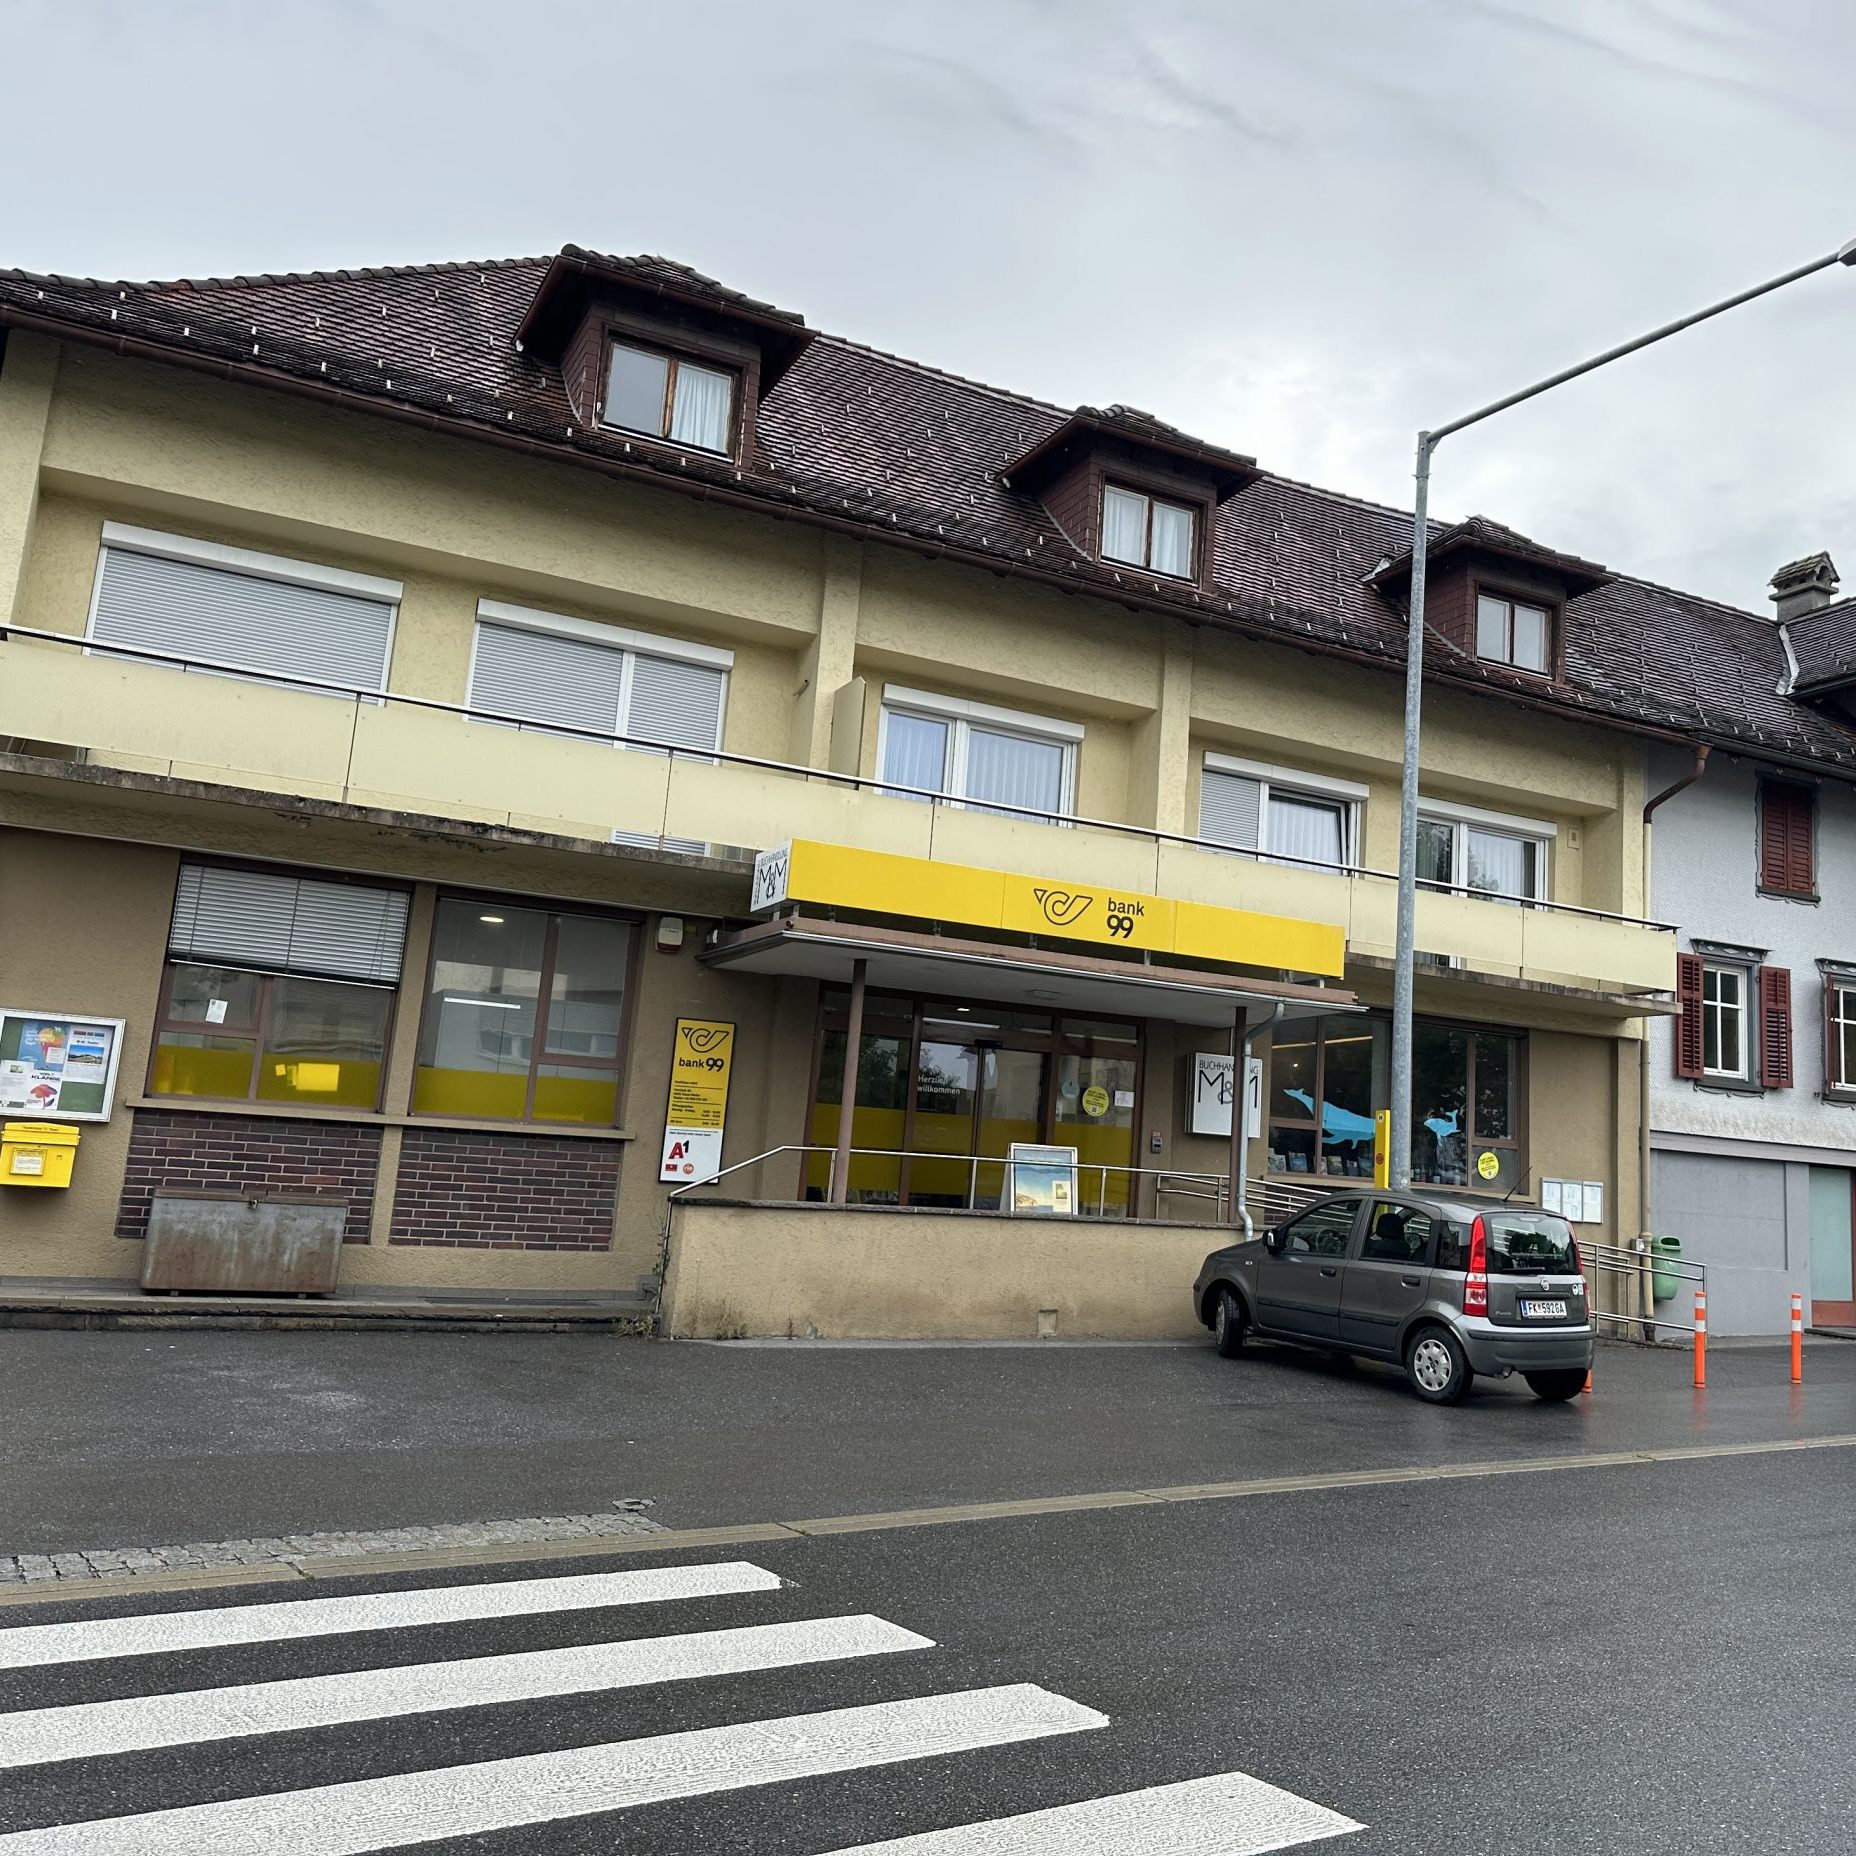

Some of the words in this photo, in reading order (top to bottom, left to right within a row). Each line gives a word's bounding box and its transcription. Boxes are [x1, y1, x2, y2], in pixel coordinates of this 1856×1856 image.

[756, 858, 787, 904] M&M
[1108, 897, 1145, 917] bank
[1106, 914, 1134, 939] 99
[1199, 1060, 1259, 1075] BUCHHANNG
[917, 1074, 949, 1086] Herzlich
[917, 1085, 961, 1096] willkommen
[668, 1139, 690, 1160] A1
[1528, 1302, 1538, 1314] FK
[1541, 1302, 1565, 1314] 592GA
